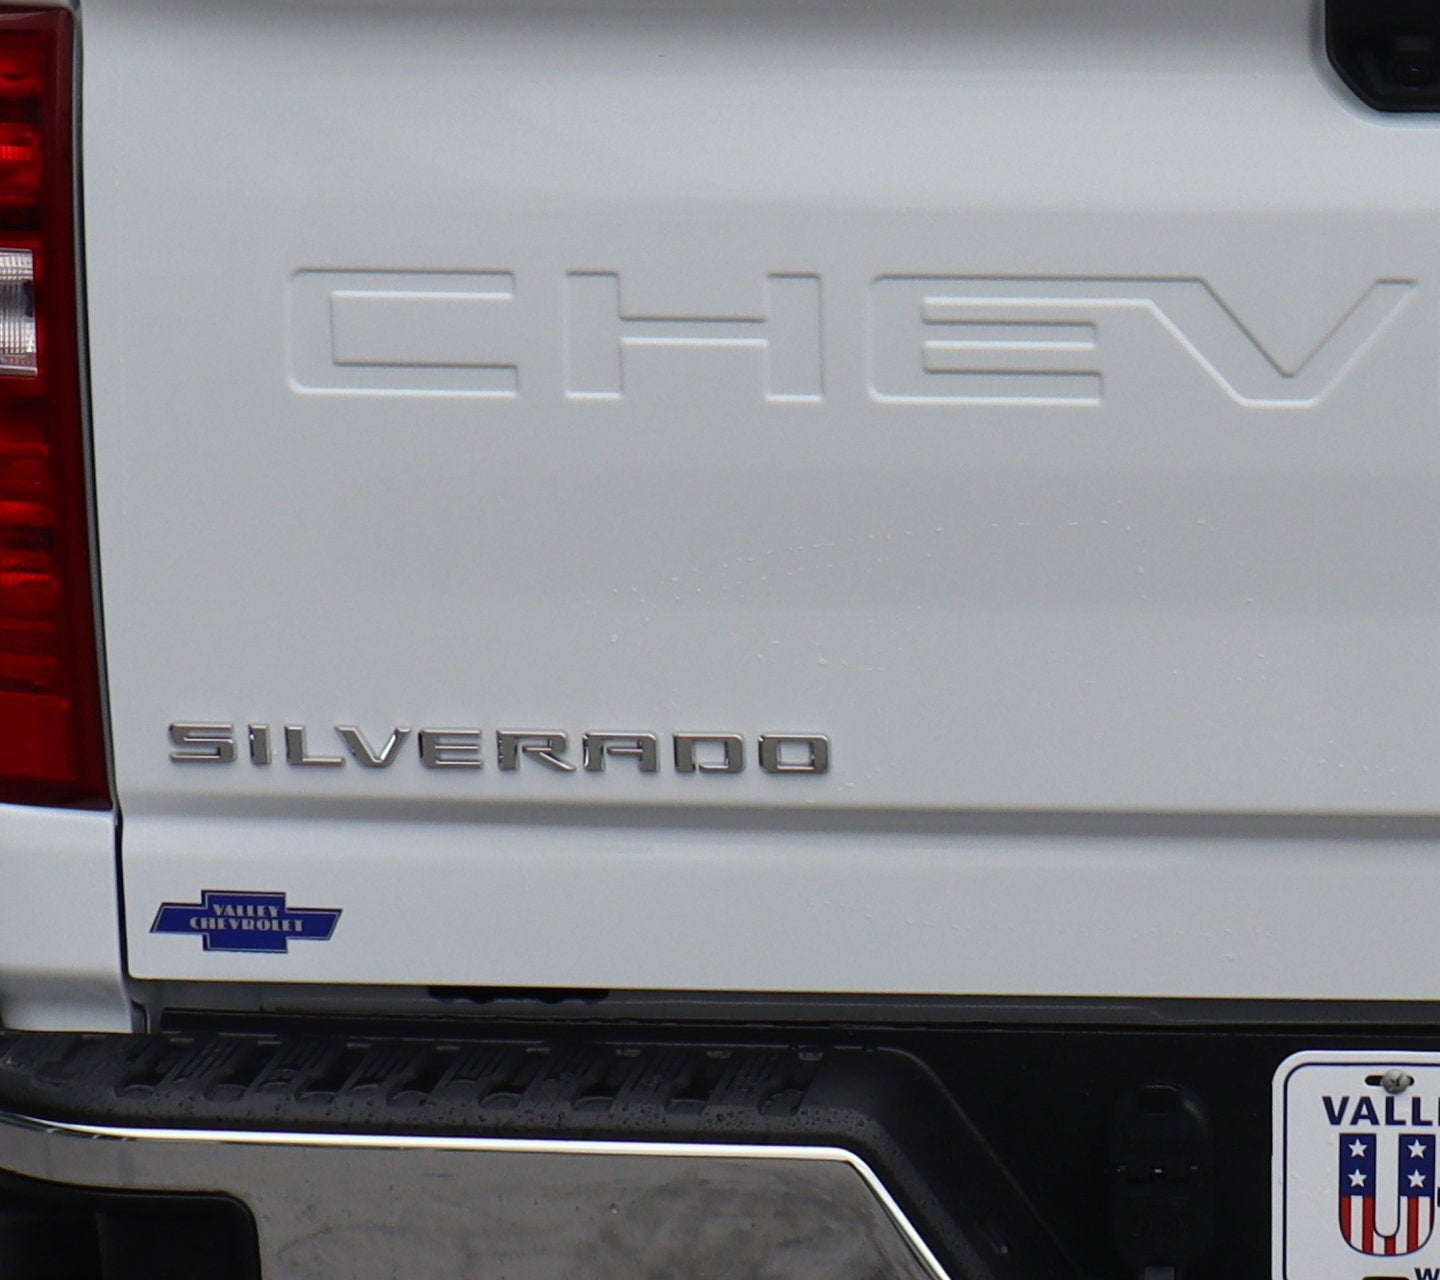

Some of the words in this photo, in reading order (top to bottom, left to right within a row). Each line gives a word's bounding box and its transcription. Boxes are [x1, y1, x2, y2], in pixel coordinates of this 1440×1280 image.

[168, 722, 832, 774] SILVERADO
[212, 903, 280, 918] VALLEY
[189, 916, 304, 932] CHEVROLET
